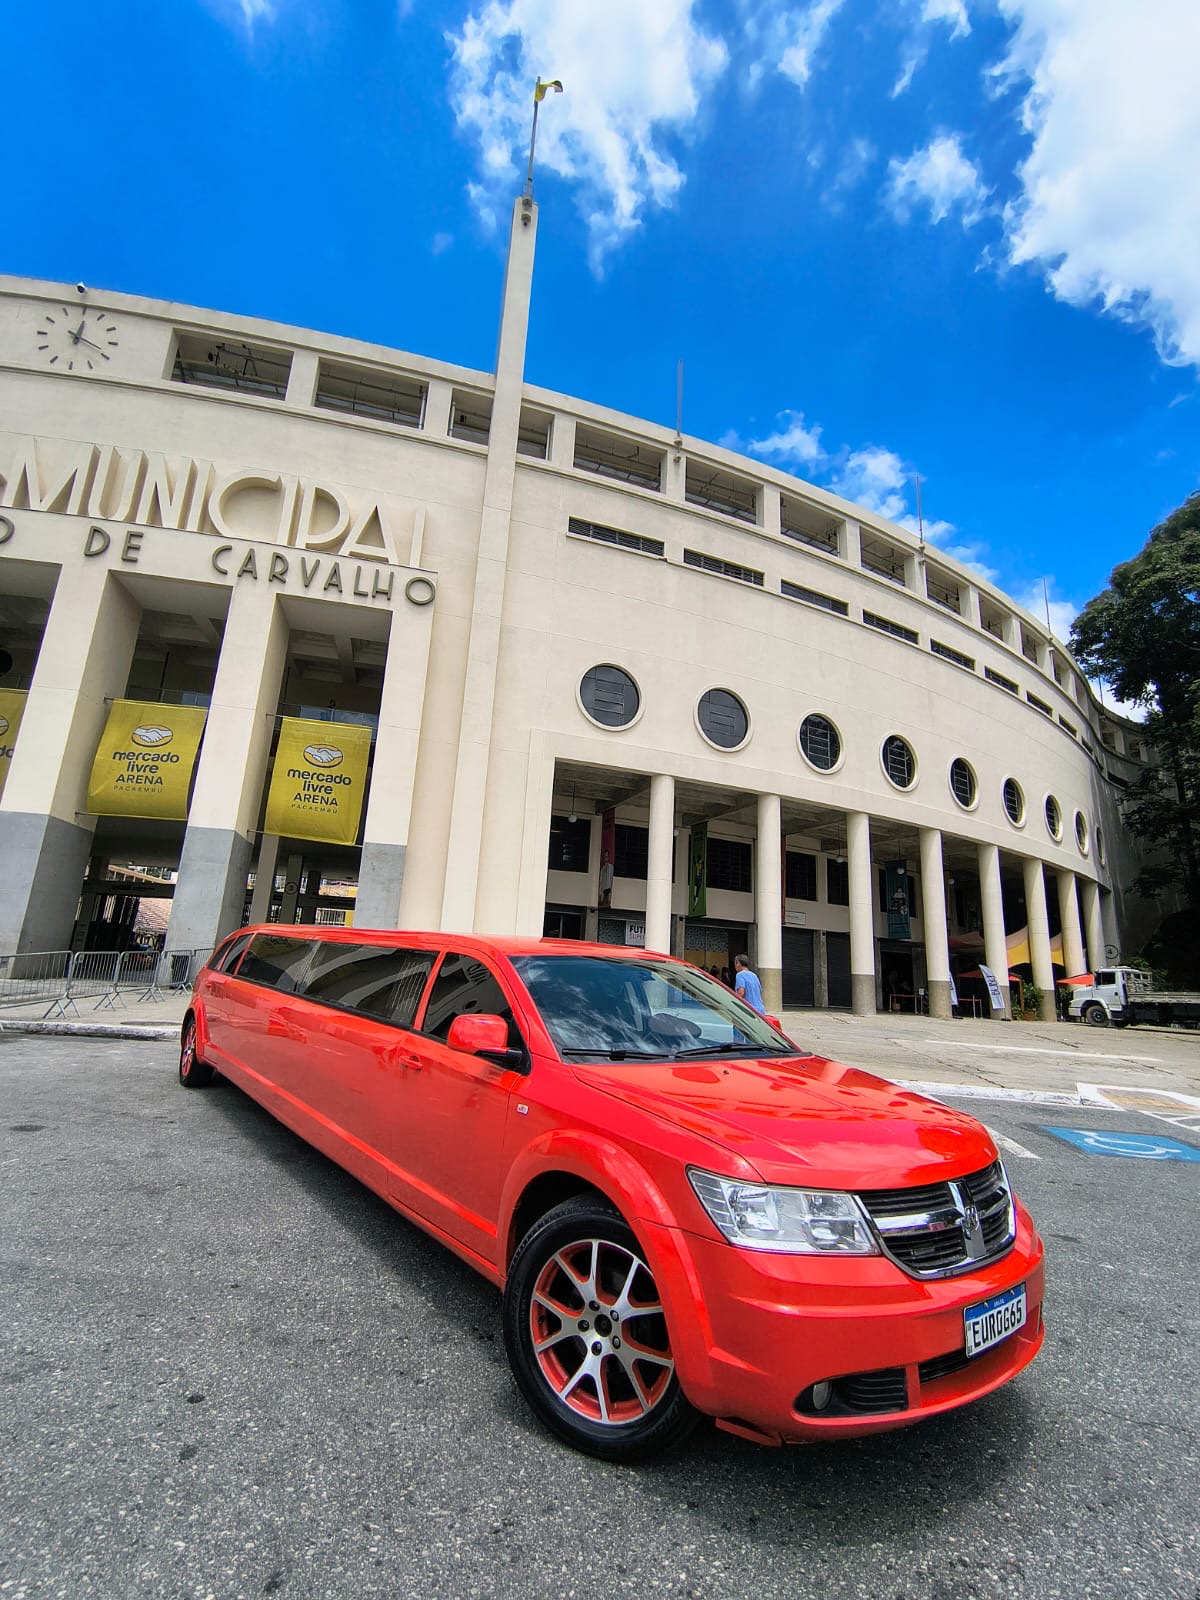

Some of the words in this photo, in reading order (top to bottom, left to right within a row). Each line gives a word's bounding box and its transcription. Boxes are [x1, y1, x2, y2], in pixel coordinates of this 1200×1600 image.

[84, 525, 144, 562] DE
[211, 545, 436, 605] CARVALHO
[112, 751, 180, 764] mercado
[126, 761, 159, 773] livre
[115, 774, 163, 785] ARENA
[287, 768, 352, 786] mercado
[302, 780, 333, 795] livre
[293, 792, 338, 807] ARENA
